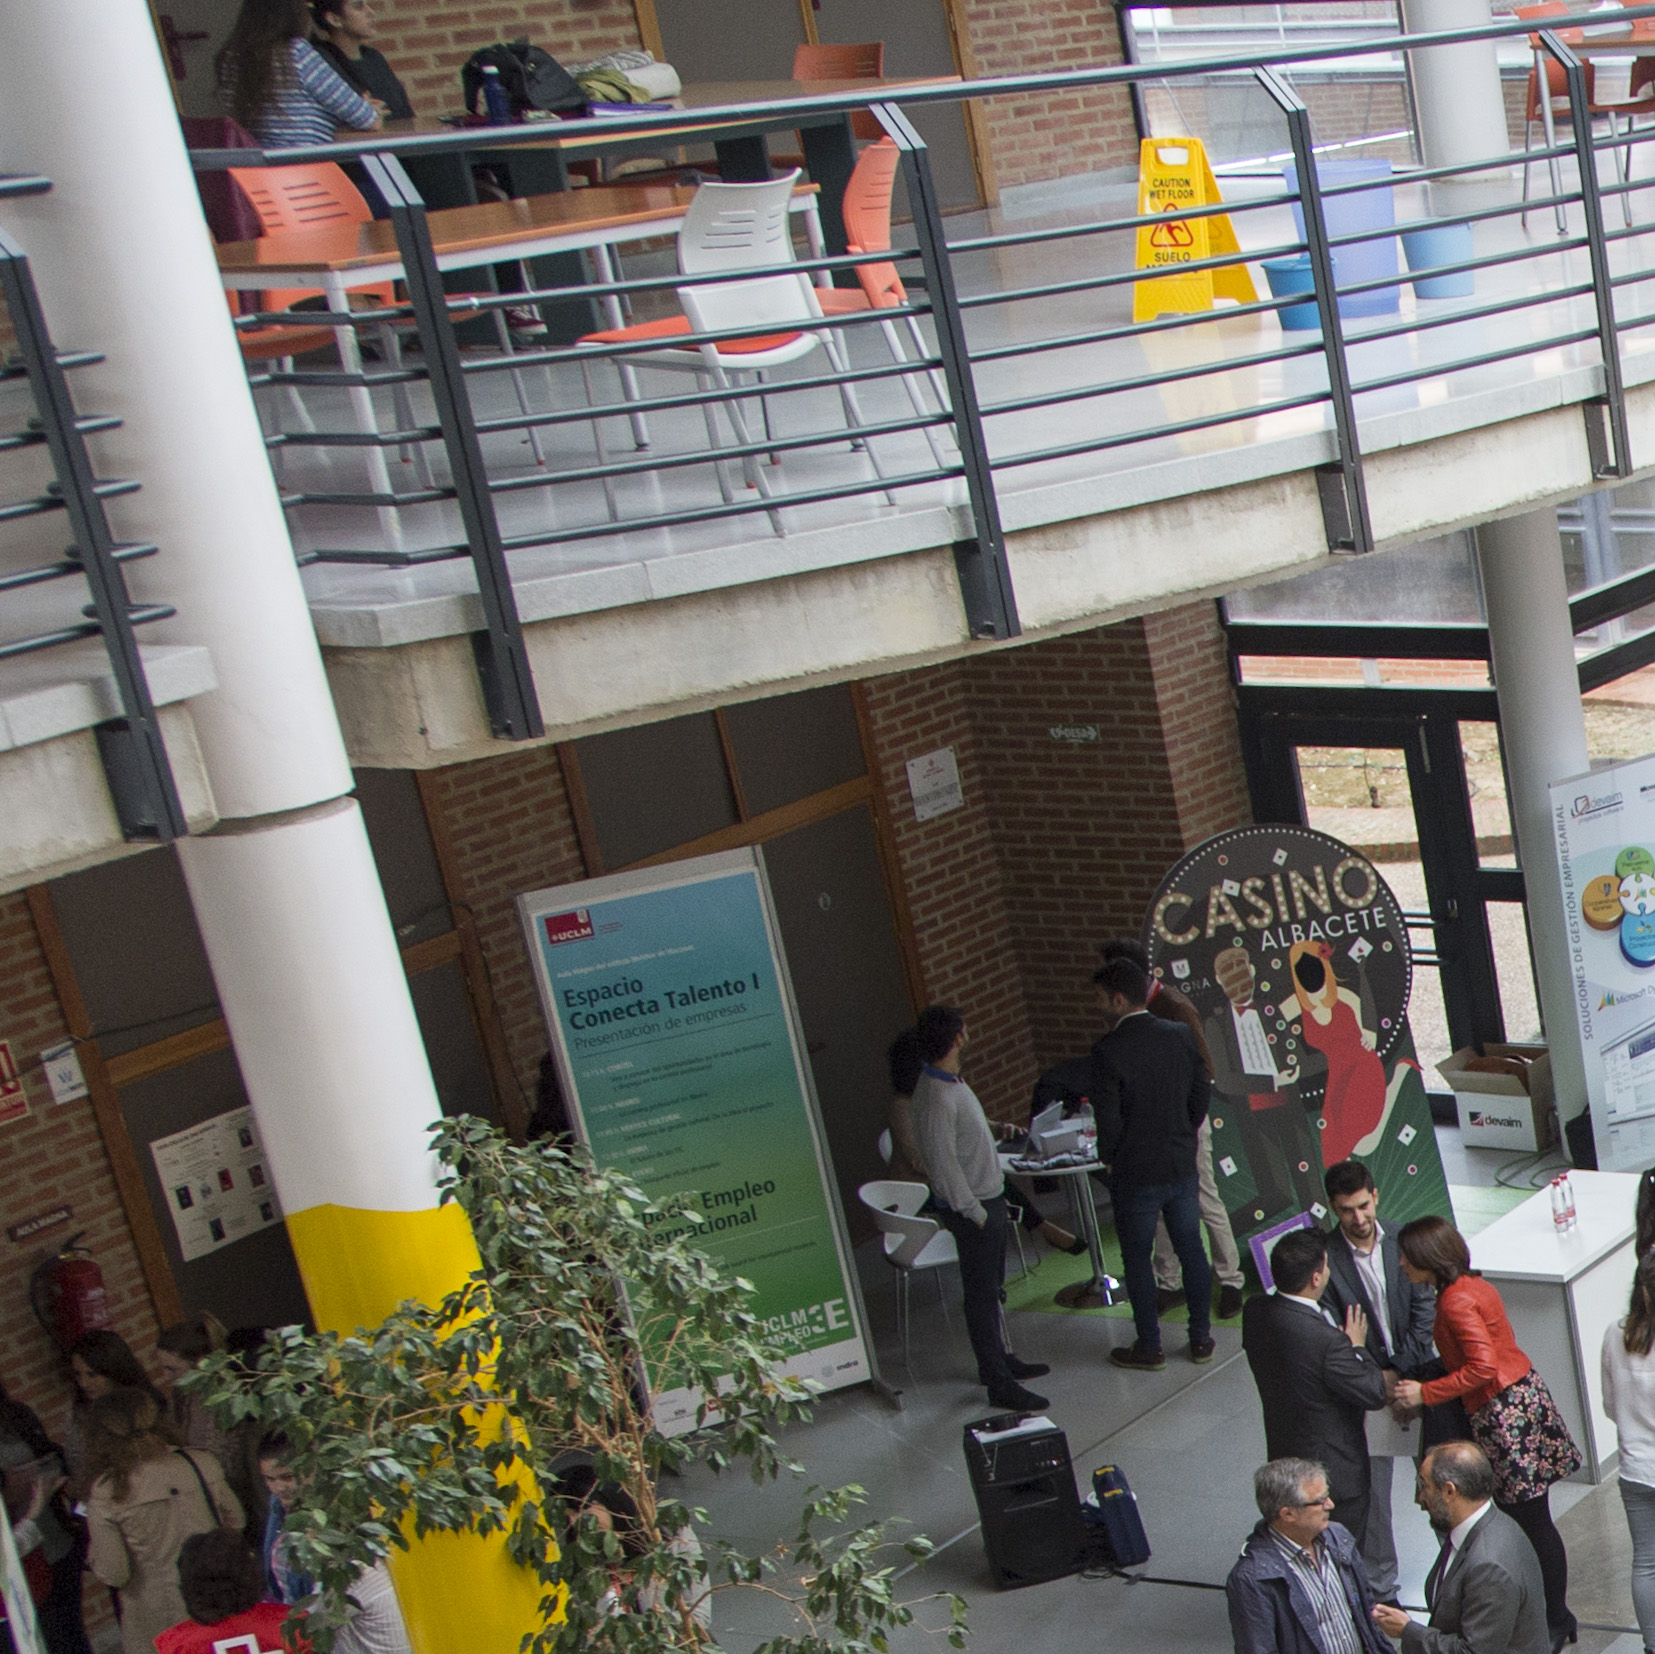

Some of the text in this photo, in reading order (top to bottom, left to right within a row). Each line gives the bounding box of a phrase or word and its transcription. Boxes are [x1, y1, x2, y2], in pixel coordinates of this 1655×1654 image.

[1149, 189, 1195, 199] WET FLOOR
[1152, 177, 1190, 188] CAUTION
[1154, 251, 1191, 262] SUELO
[1556, 804, 1575, 892] EMPRESARIAL
[1153, 857, 1378, 946] CASINO
[558, 926, 592, 941] UCLM
[1261, 907, 1387, 952] ALBACETE
[1567, 895, 1581, 946] GESTIÓN
[563, 976, 643, 1008] Espacio
[569, 997, 660, 1031] Conecta
[665, 977, 747, 1010] Talento
[1576, 968, 1593, 1040] SOLUCIONES
[1615, 987, 1647, 1005] Microsoft
[574, 1001, 748, 1050] Presentación de empresas
[1485, 1115, 1522, 1129] devaim
[701, 1179, 776, 1210] Empleo
